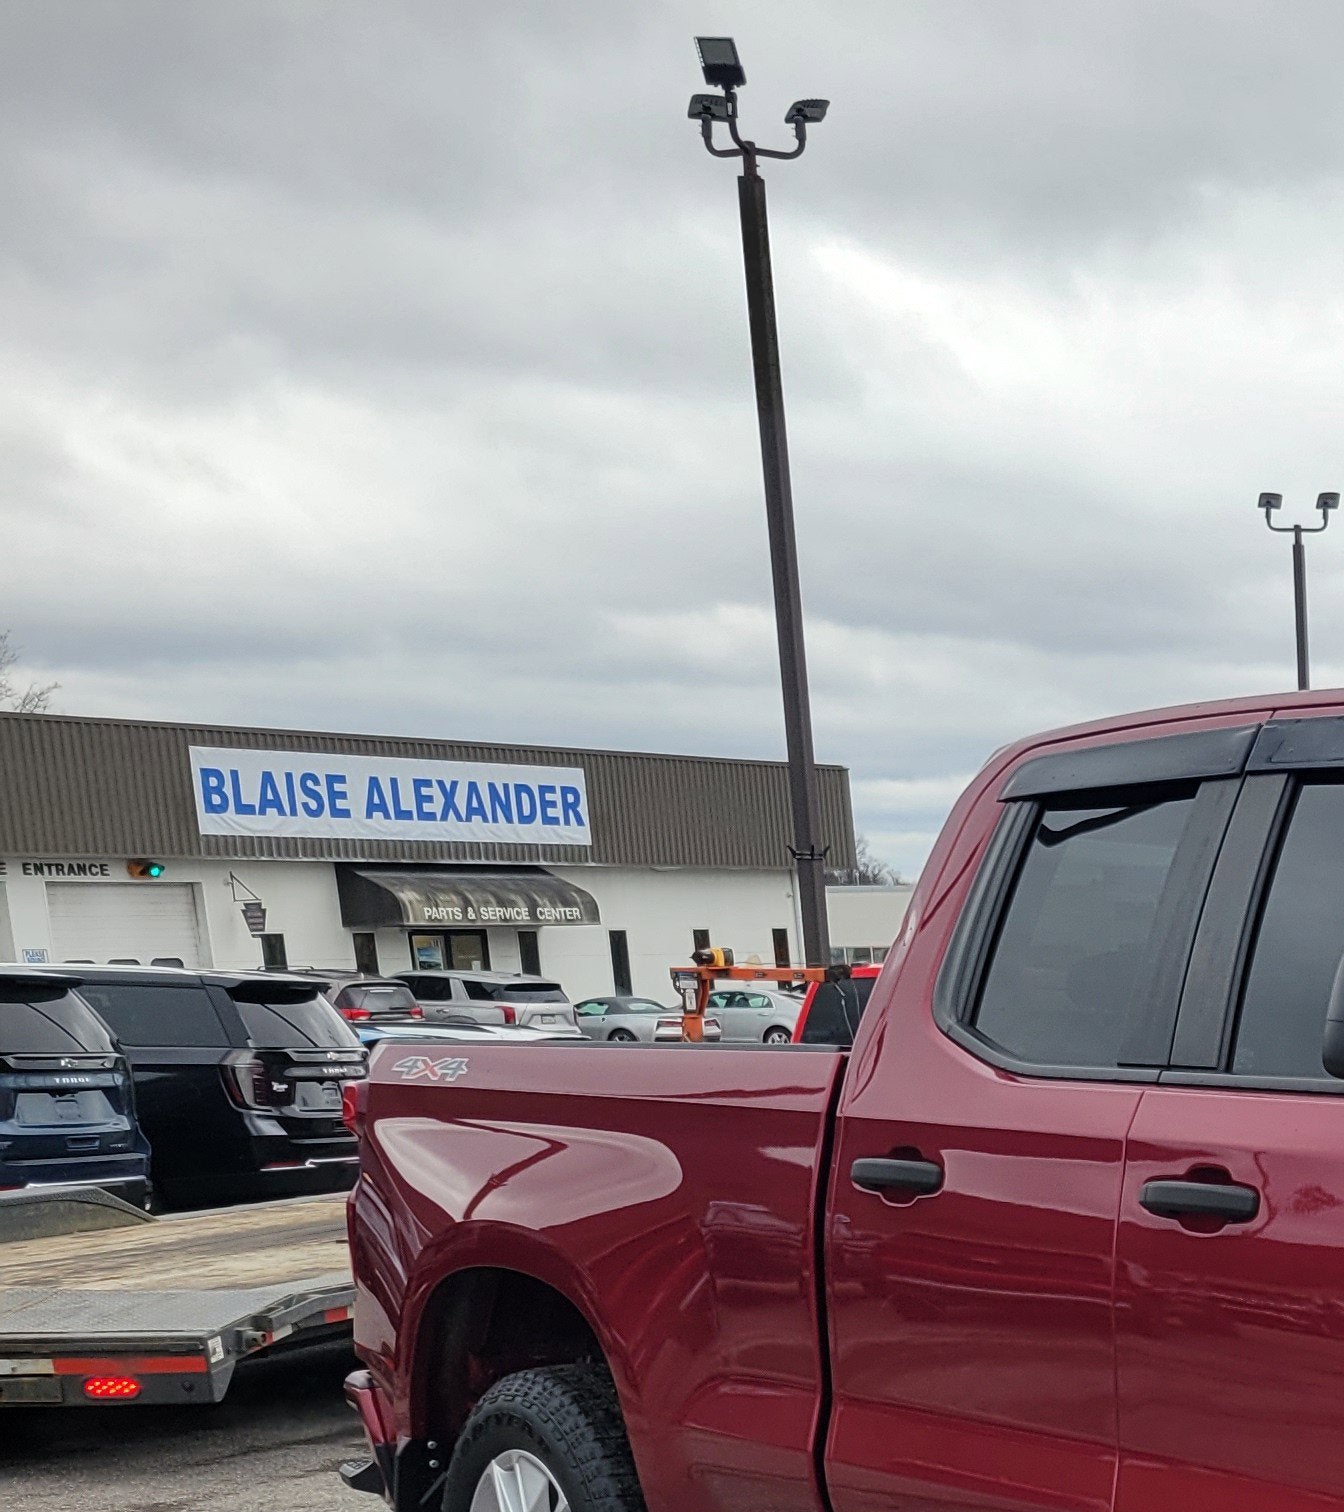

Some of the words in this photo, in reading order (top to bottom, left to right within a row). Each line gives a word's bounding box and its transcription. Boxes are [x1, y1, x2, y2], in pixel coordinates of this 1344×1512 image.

[199, 767, 352, 819] BLAISE
[365, 775, 586, 827] ALEXANDER
[22, 862, 110, 876] ENTRANCE
[423, 906, 463, 920] PARTS
[467, 907, 477, 920] &
[480, 907, 530, 920] SERVICE
[536, 907, 582, 920] CENTER
